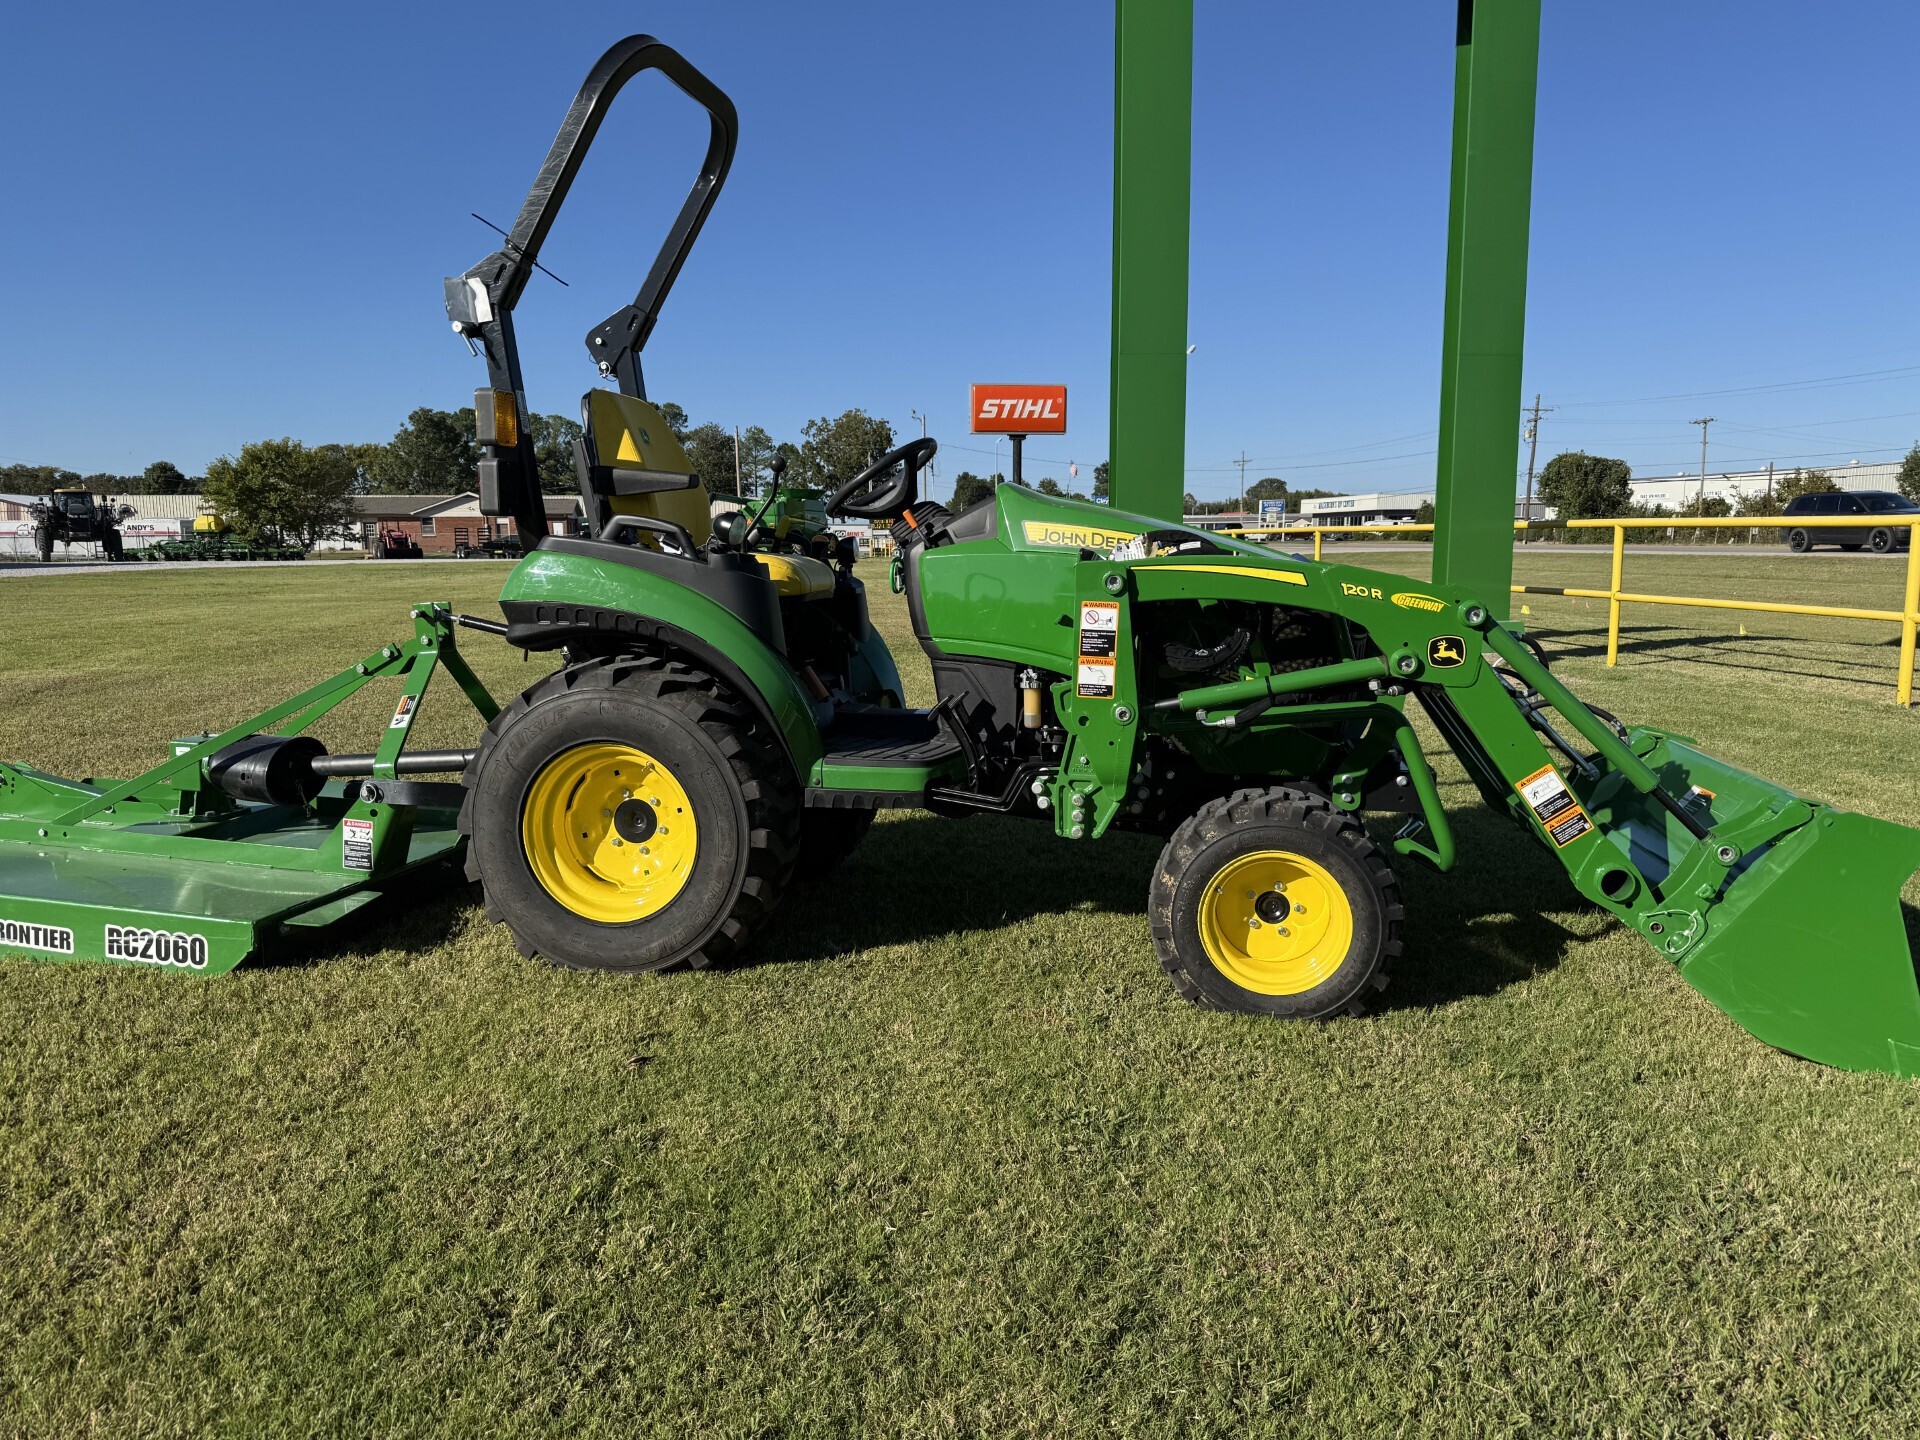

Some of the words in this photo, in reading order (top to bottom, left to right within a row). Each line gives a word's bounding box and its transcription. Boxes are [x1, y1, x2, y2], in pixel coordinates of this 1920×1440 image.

[978, 398, 1060, 419] STIHL
[126, 524, 155, 532] ANDY'S
[835, 530, 847, 538] GO
[1038, 528, 1087, 546] JOHN
[1340, 582, 1369, 597] 120
[1370, 587, 1384, 601] R
[1397, 594, 1445, 613] GREENWAY
[1085, 658, 1114, 666] WARNING
[1526, 767, 1549, 784] WARNING
[1555, 809, 1579, 825] WARNING
[107, 926, 206, 967] RC2060
